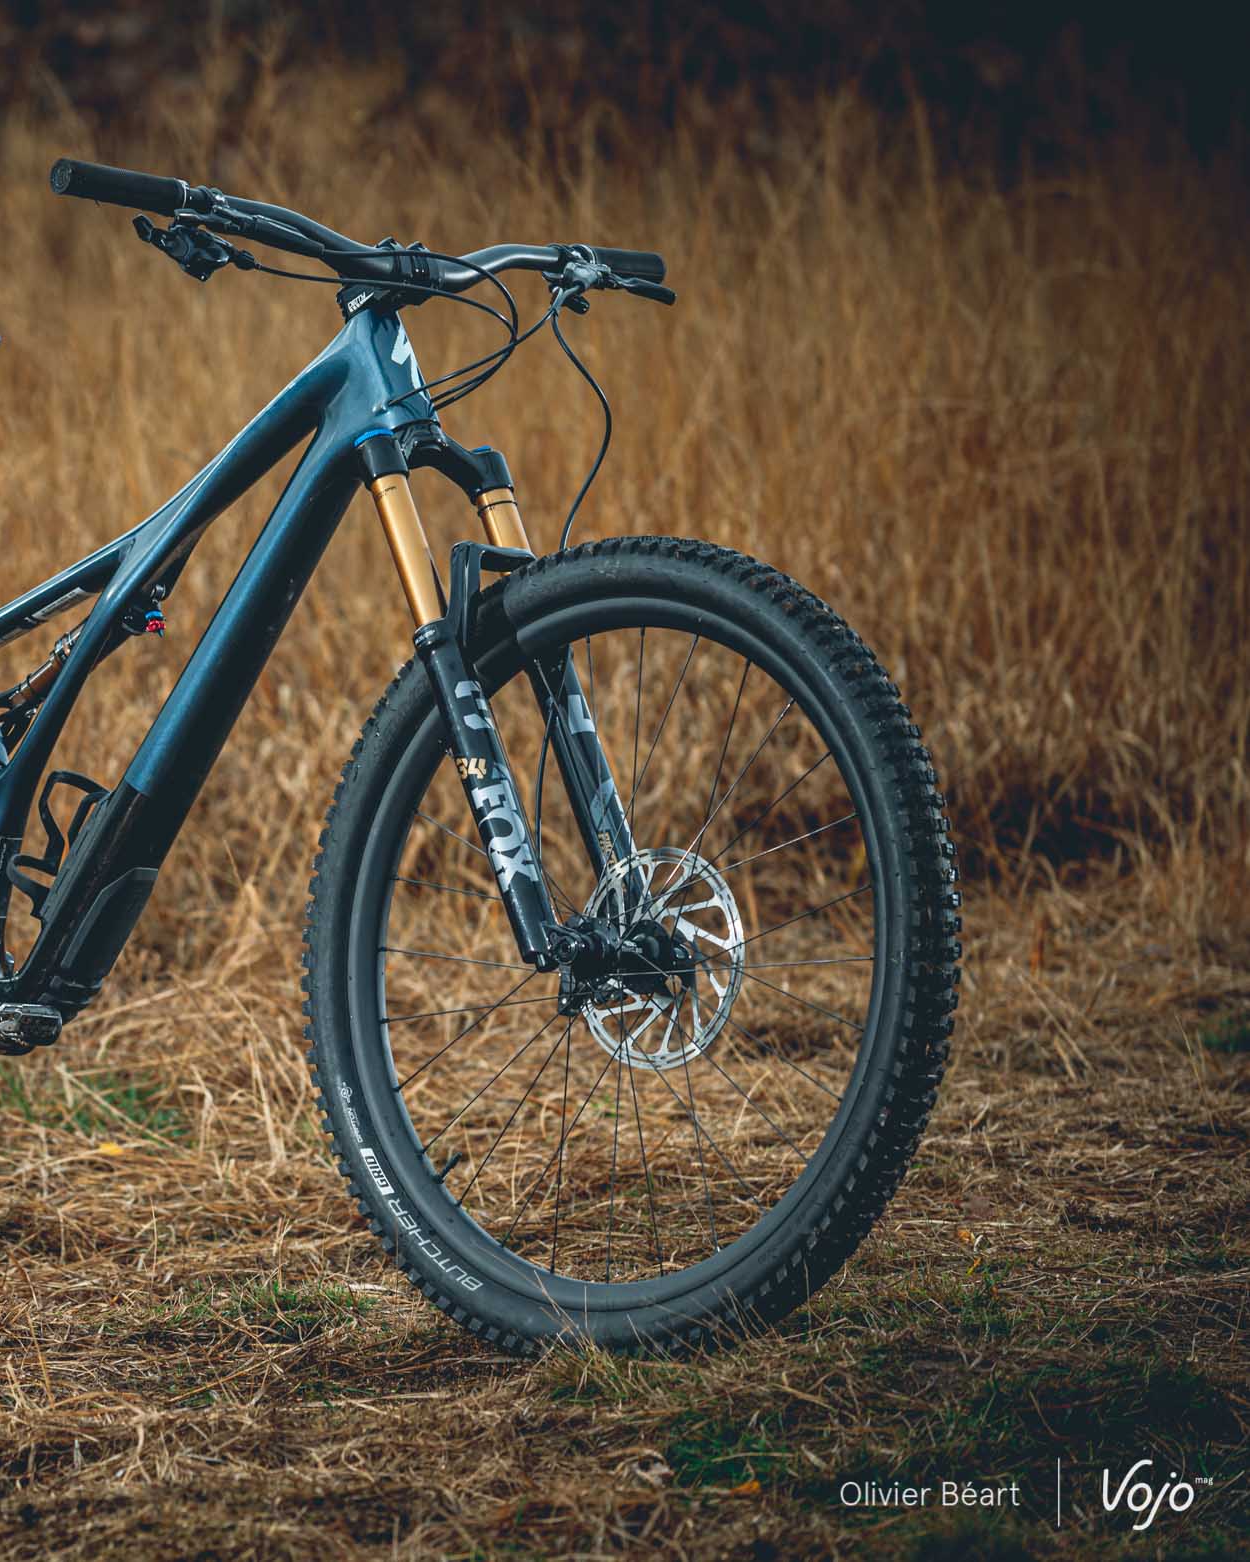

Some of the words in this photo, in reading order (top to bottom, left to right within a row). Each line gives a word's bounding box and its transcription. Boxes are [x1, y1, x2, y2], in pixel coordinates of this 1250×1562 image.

[455, 757, 487, 780] 34
[471, 779, 540, 893] FOX
[365, 1154, 390, 1189] GRID
[387, 1198, 484, 1292] BUTCHER
